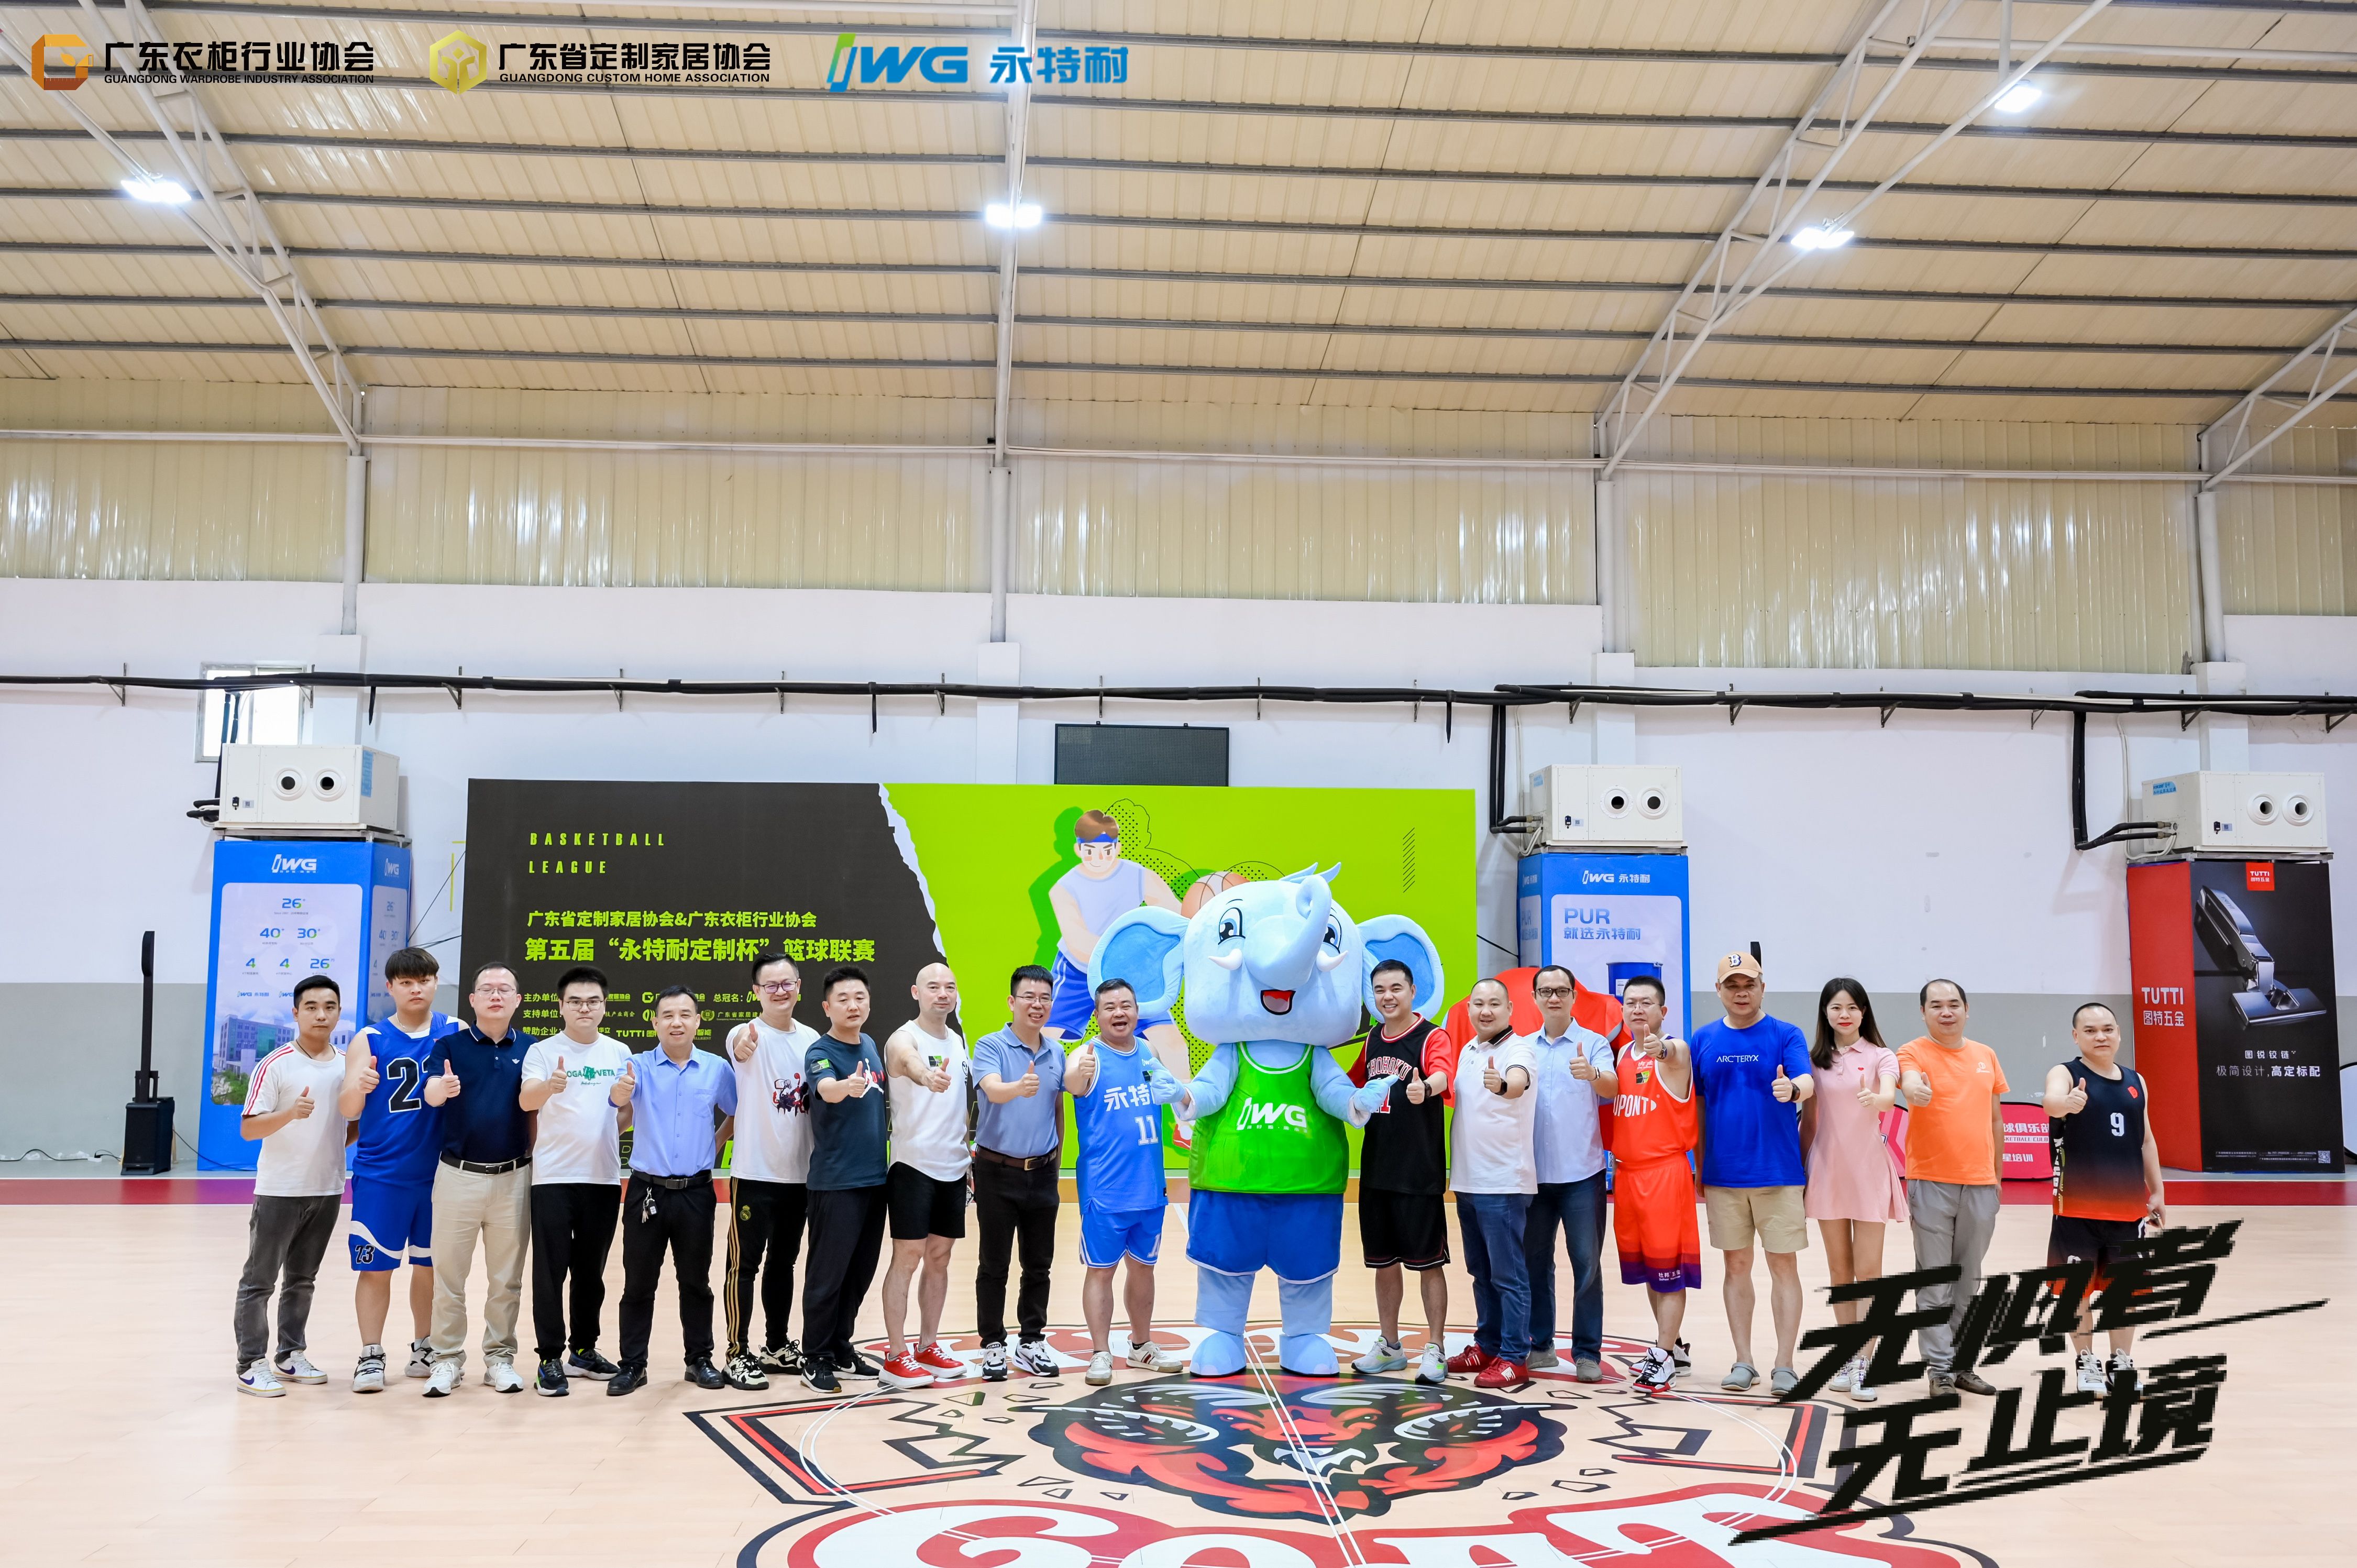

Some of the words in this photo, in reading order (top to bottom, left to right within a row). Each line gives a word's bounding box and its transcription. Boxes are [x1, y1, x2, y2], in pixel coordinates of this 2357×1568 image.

[530, 833, 665, 846] BASKETBALL
[528, 860, 607, 874] LEAGUE
[1618, 874, 1650, 883] 永特耐
[527, 911, 817, 929] 广东省定制家居协会&广东衣柜行业协会
[1564, 908, 1610, 924] PUR
[1563, 926, 1640, 940] 就选永特耐
[1728, 953, 1742, 967] B
[2141, 987, 2184, 1005] TUTTI
[2143, 1010, 2185, 1026] 图特五金
[1104, 1083, 1155, 1111] 永特
[1613, 1095, 1649, 1118] UPONT
[1135, 1114, 1159, 1146] 11
[2110, 1112, 2124, 1136] 9
